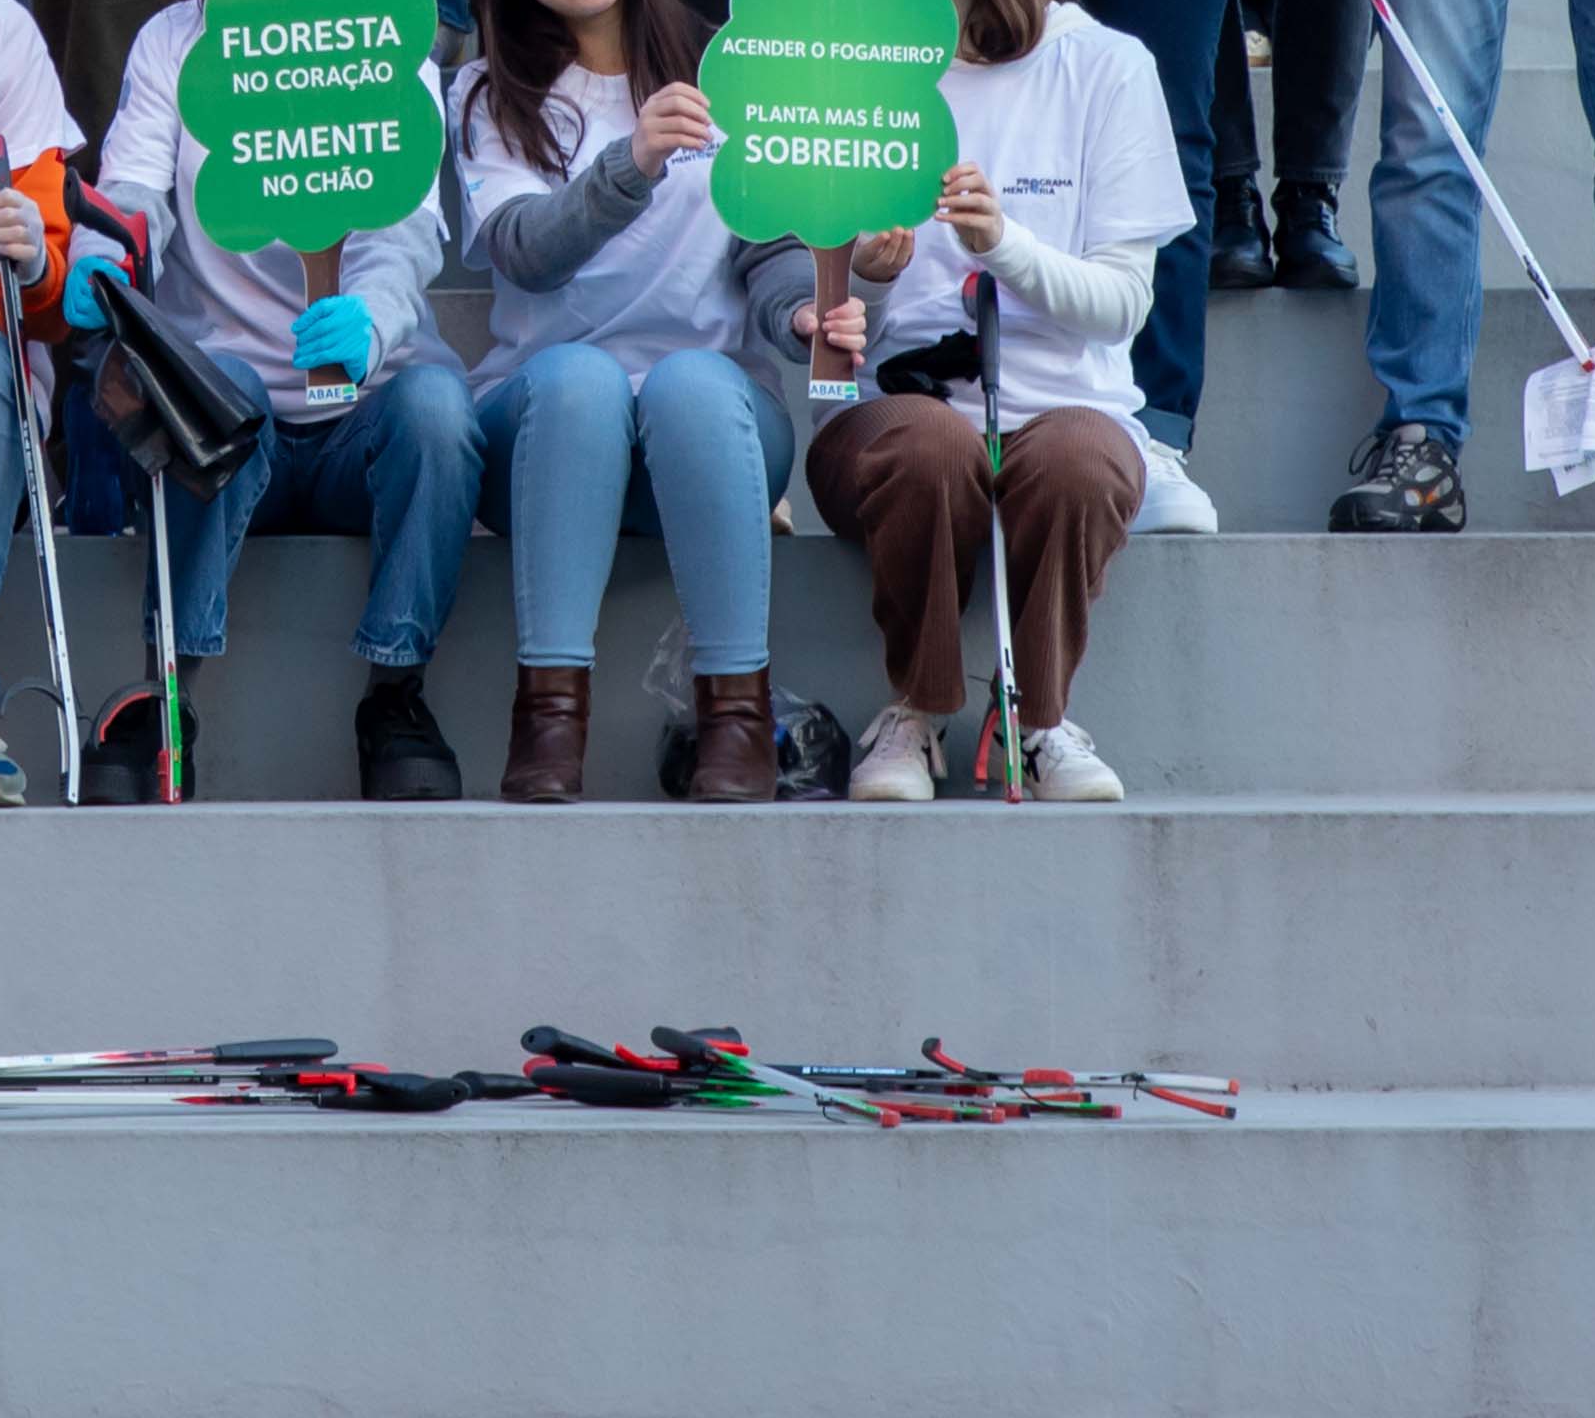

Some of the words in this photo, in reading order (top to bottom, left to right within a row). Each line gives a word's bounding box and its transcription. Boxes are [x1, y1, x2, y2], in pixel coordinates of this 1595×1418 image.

[222, 16, 402, 58] FLORESTA
[722, 38, 806, 58] ACENDER
[811, 42, 825, 59] O
[830, 43, 945, 64] FOGAREIRO?
[233, 72, 268, 94] NO
[275, 59, 393, 91] CORAÇÃO
[746, 104, 820, 124] PLANTA
[825, 108, 868, 127] MAS
[873, 106, 883, 128] É
[889, 111, 920, 128] UM
[232, 121, 401, 164] SEMENTE
[745, 134, 920, 171] SOBREIRO!
[263, 175, 299, 197] NO
[305, 166, 374, 194] CHÃO
[309, 386, 341, 400] ABAE
